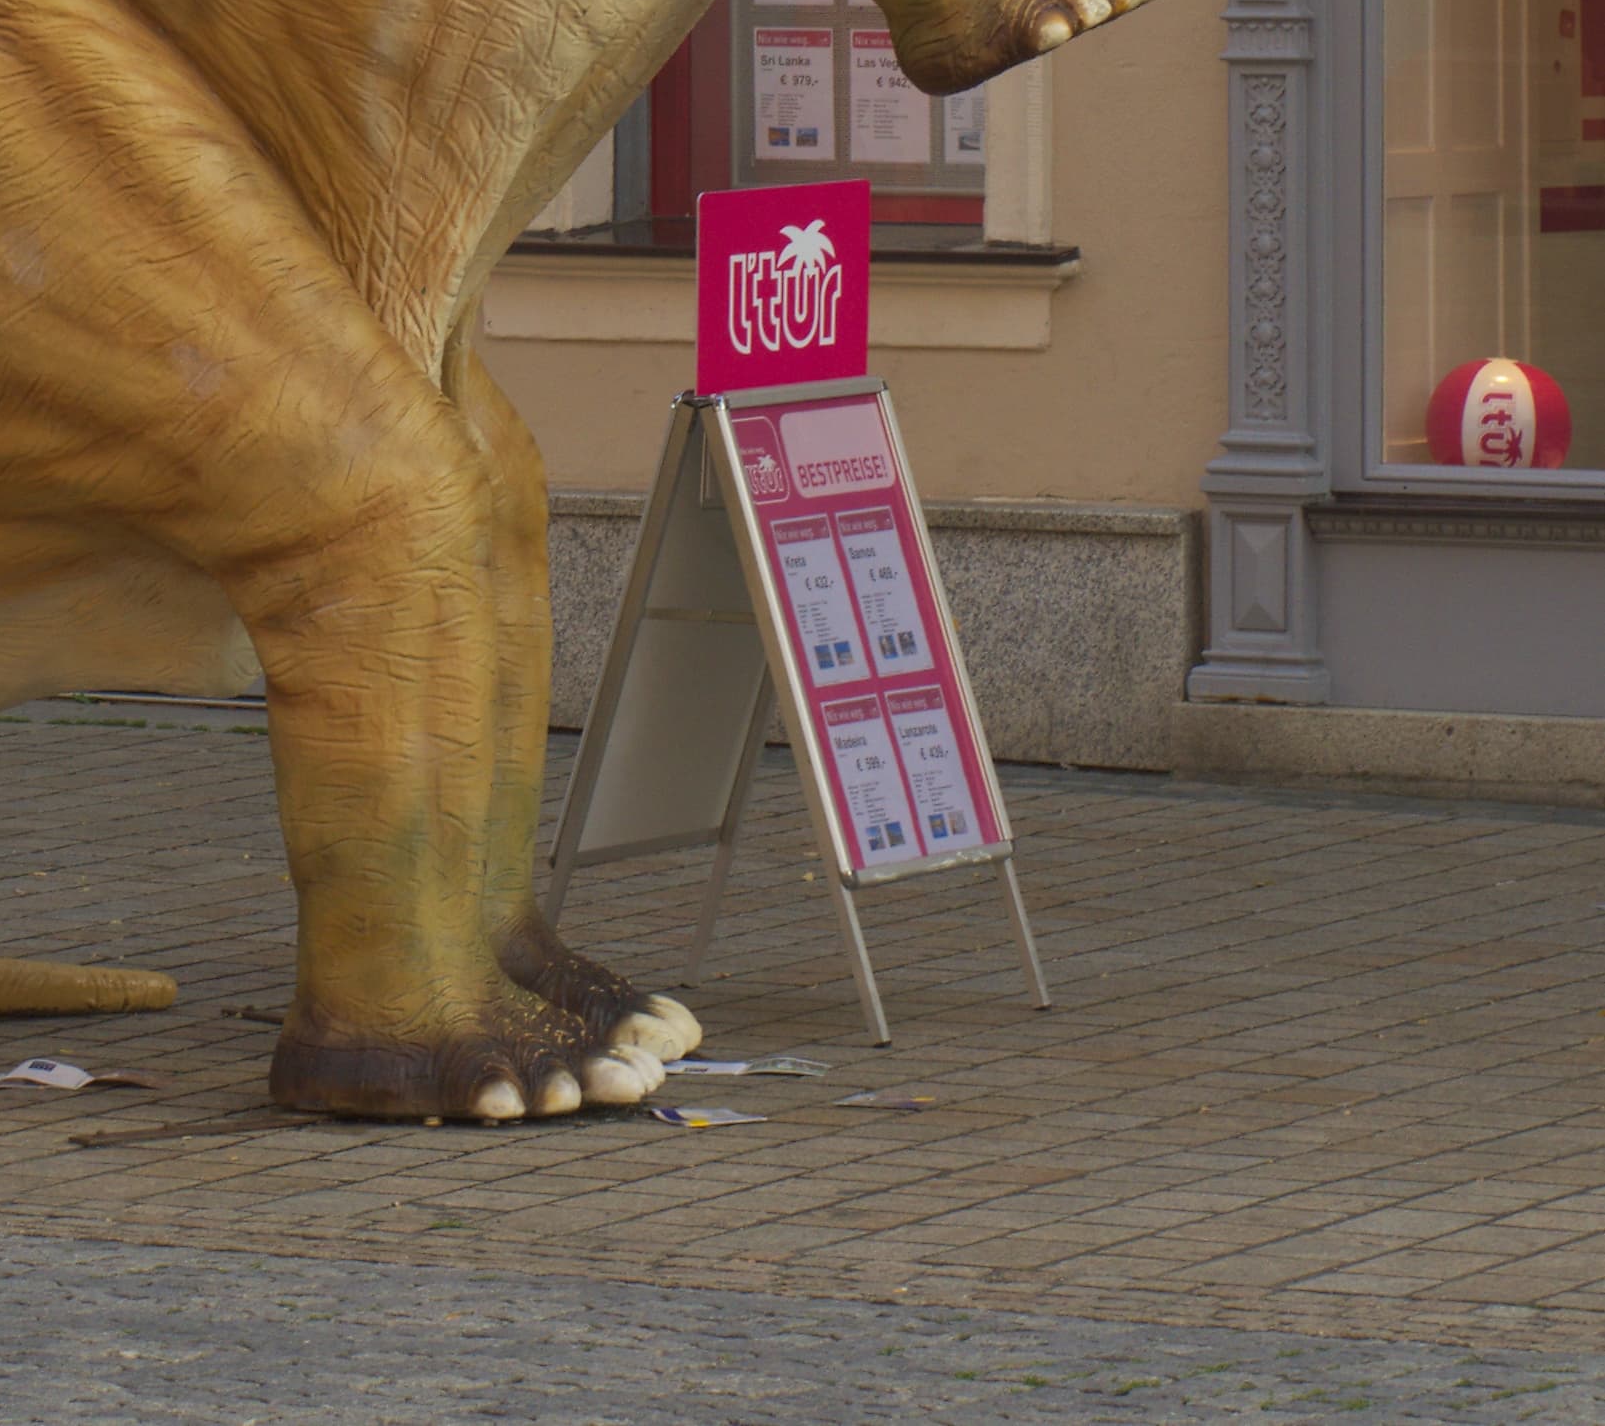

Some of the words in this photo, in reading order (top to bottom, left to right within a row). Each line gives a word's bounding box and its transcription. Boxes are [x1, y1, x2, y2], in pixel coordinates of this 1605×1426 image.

[760, 54, 775, 66] Sri
[778, 54, 811, 66] Lanka
[856, 57, 876, 68] Las
[878, 57, 899, 71] Veg
[797, 455, 889, 489] BESTPREISE!
